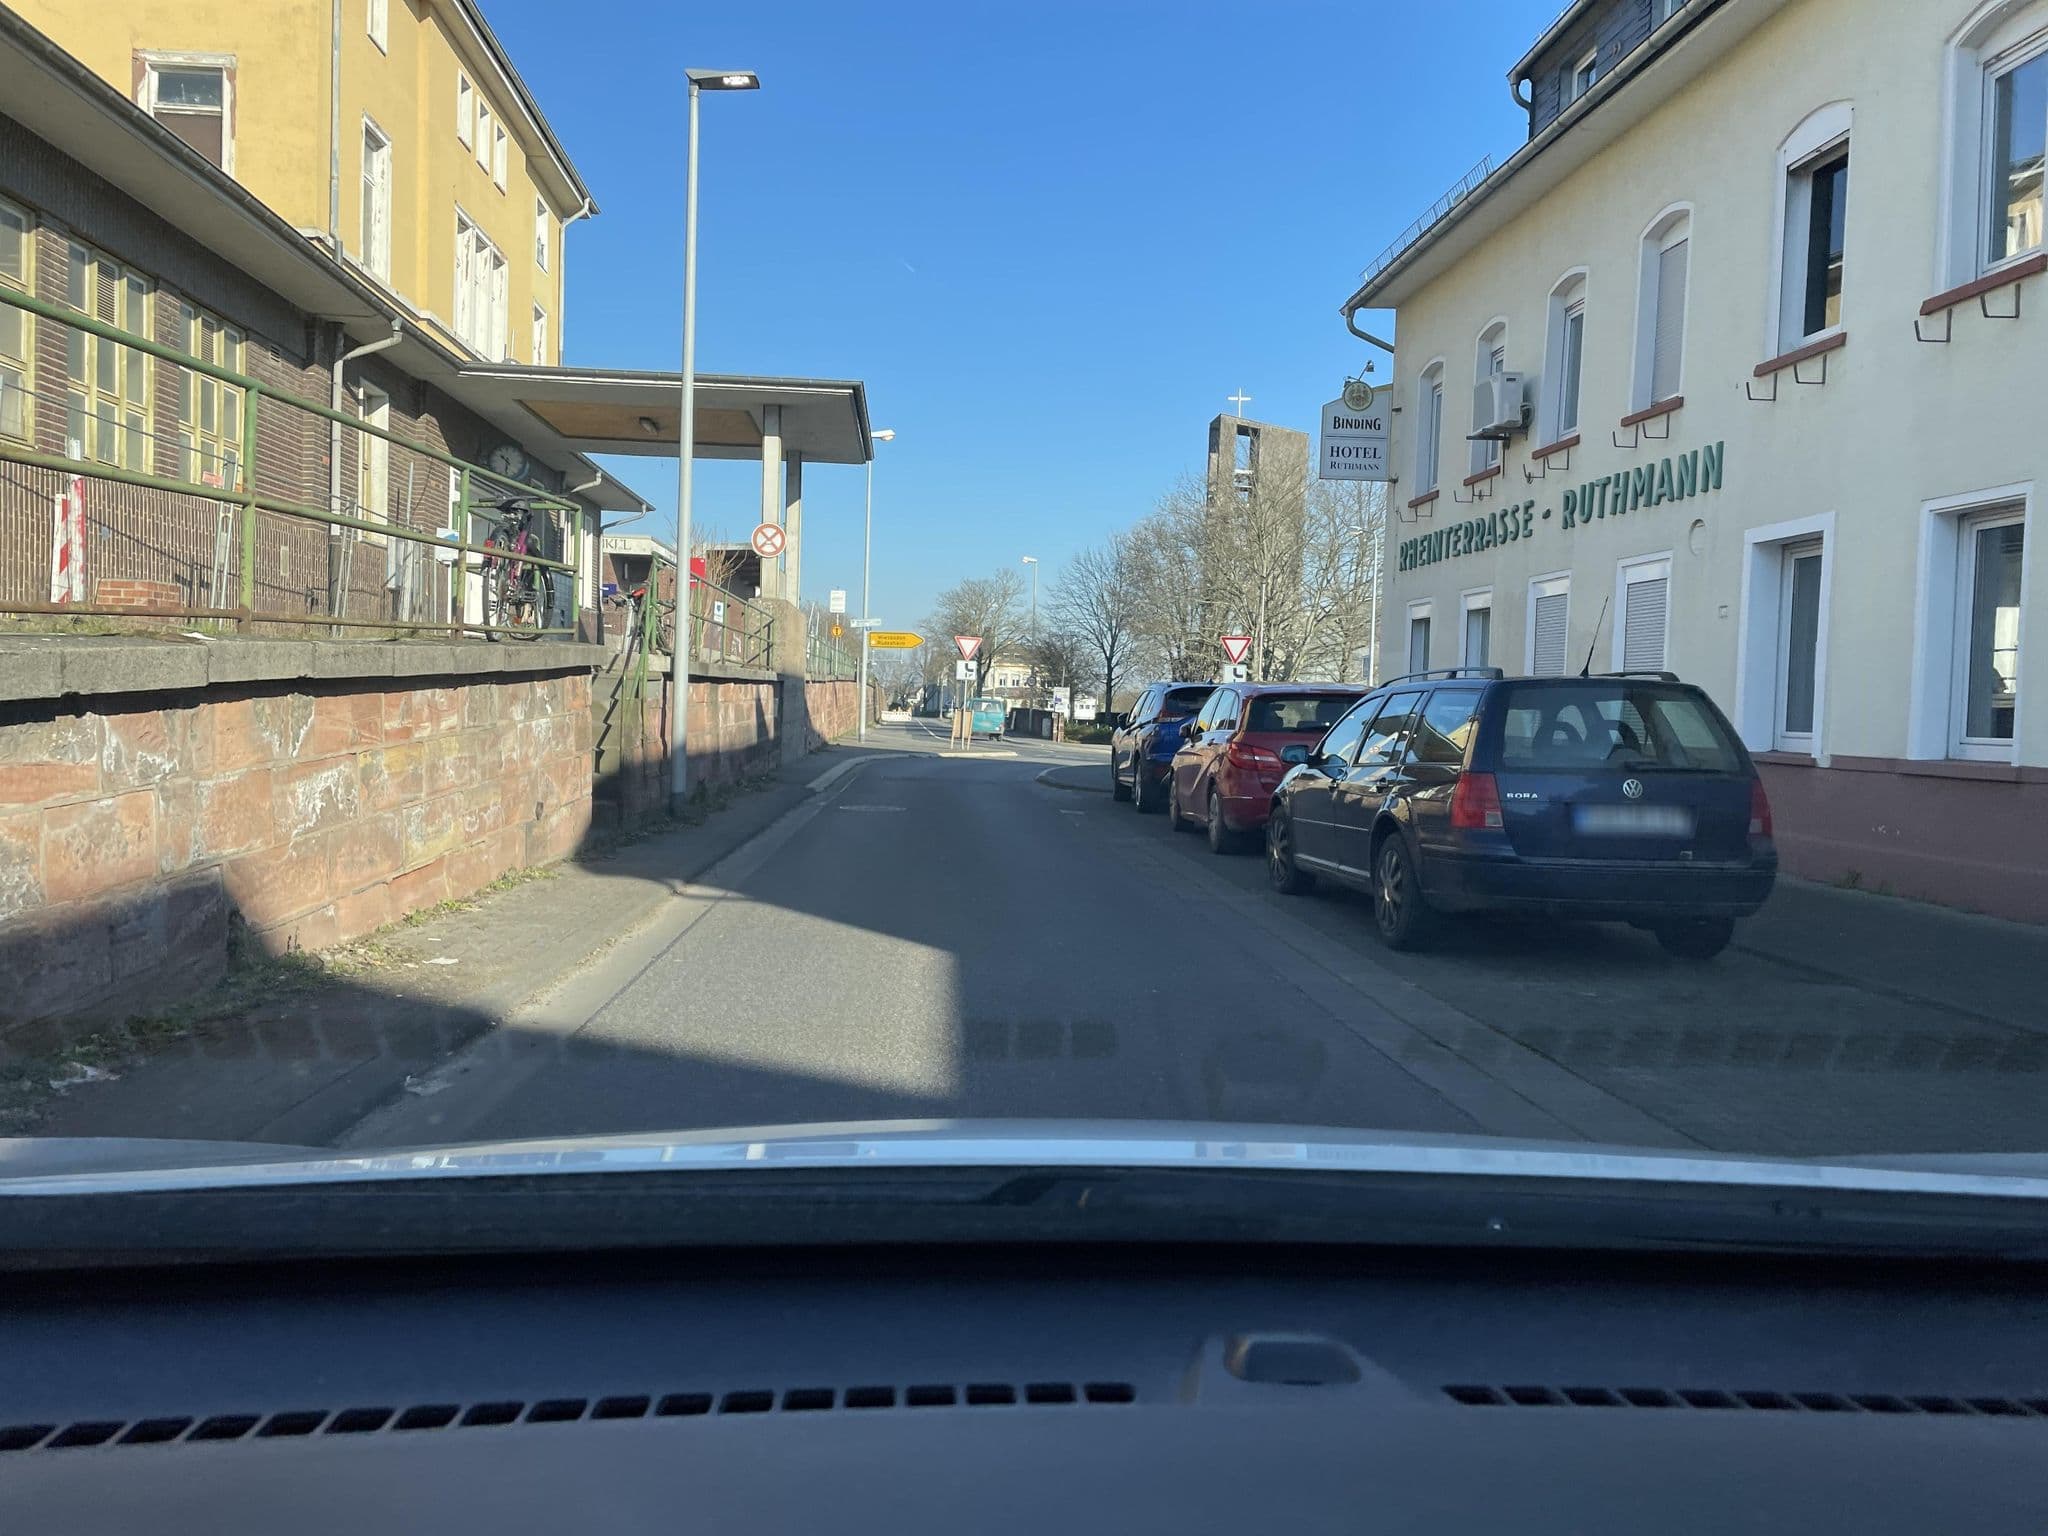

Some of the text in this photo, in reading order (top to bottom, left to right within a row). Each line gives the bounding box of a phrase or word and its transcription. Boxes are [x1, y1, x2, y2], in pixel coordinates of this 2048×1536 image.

[1333, 415, 1381, 431] BINDING
[1329, 446, 1382, 460] HOTEL
[1330, 460, 1380, 471] RUTHMANN
[1399, 499, 1535, 572] RHEINTERRASSE
[1562, 440, 1725, 530] RUTHMANN
